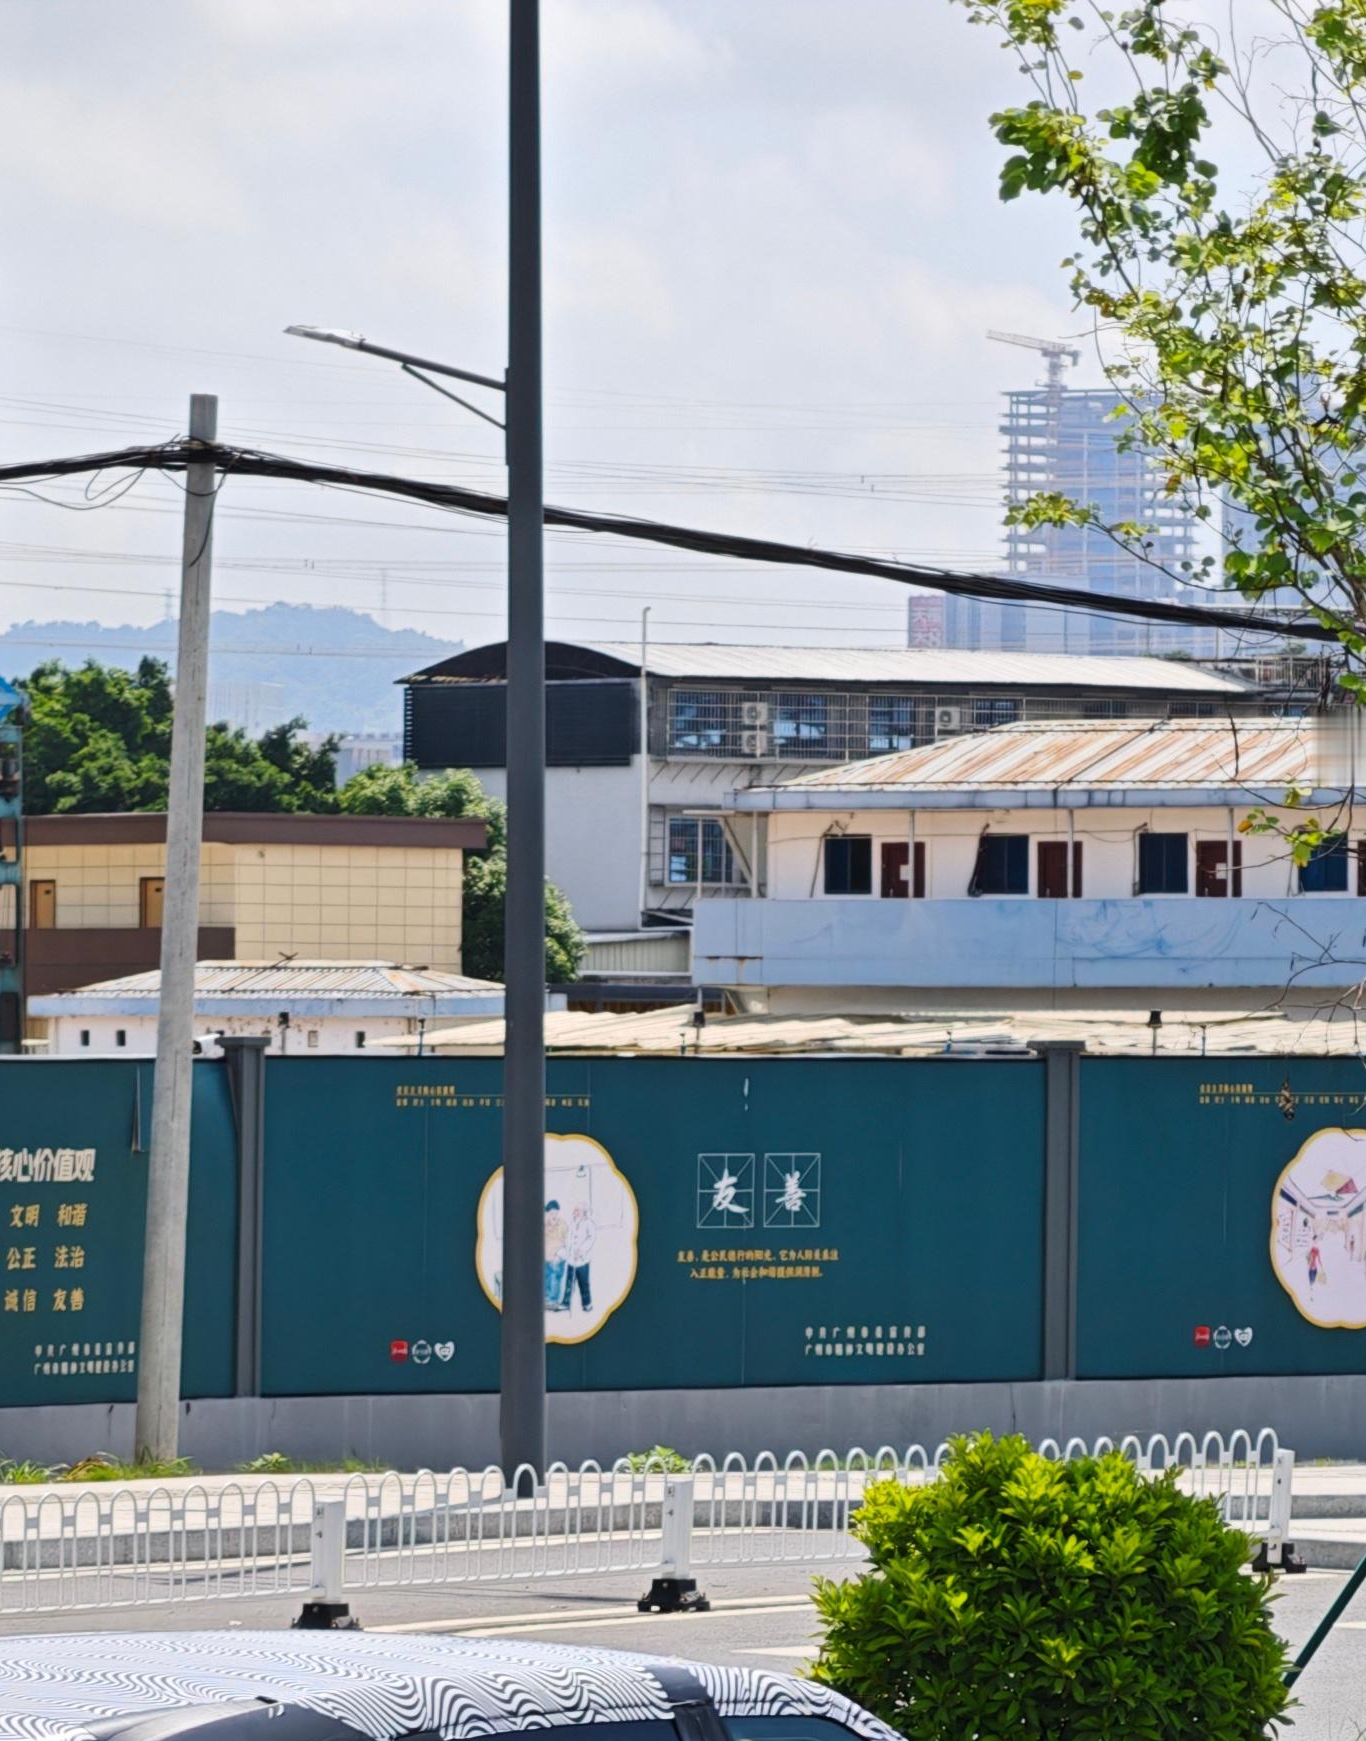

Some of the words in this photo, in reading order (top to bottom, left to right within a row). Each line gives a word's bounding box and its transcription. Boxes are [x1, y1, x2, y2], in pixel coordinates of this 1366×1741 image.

[712, 1167, 807, 1212] 友善
[10, 1204, 40, 1228] 文明
[57, 1202, 88, 1228] 和谐
[6, 1247, 37, 1270] 公正
[54, 1245, 85, 1269] 法治
[4, 1288, 37, 1313] 诚信
[53, 1287, 85, 1312] 友善
